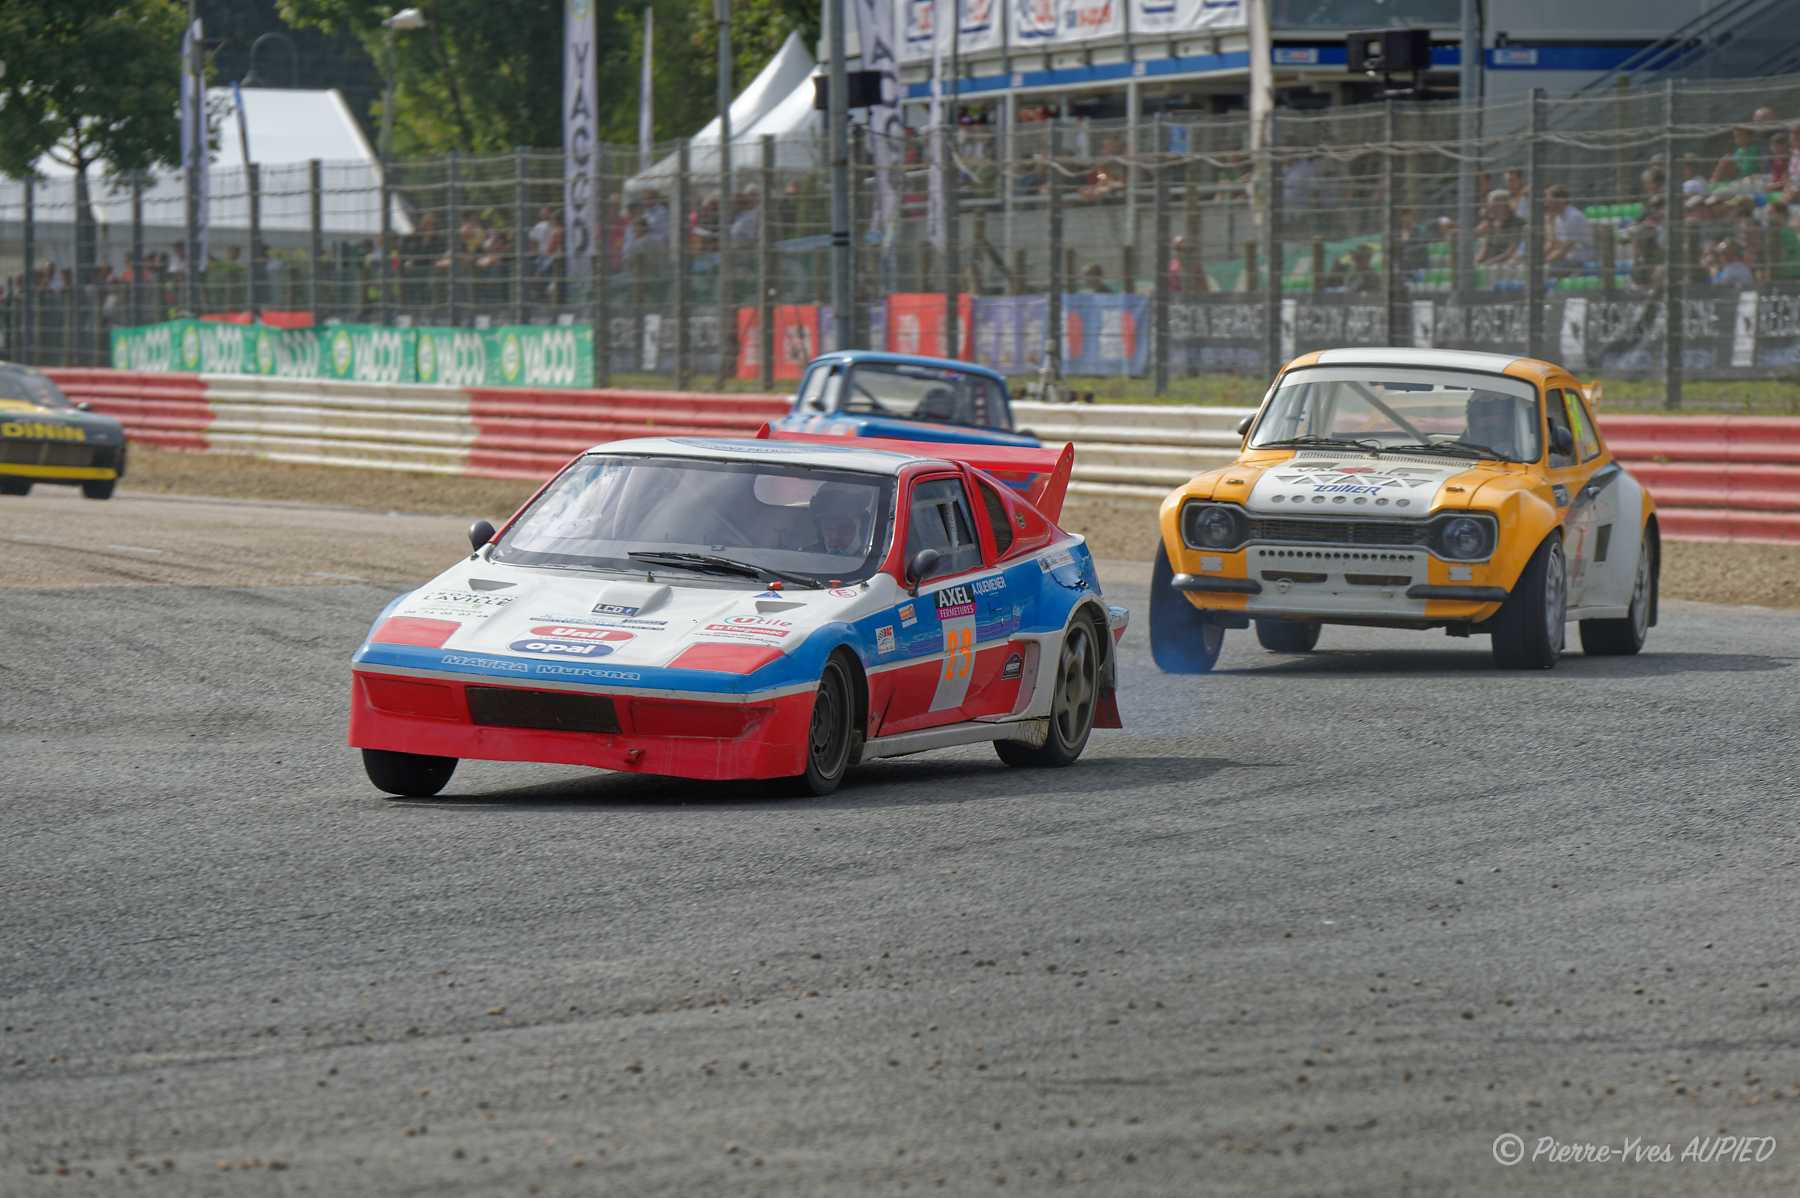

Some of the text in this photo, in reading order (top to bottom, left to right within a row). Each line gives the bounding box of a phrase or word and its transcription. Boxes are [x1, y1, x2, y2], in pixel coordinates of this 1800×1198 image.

[570, 42, 591, 256] YACCO
[202, 324, 243, 375] YACCO
[352, 331, 403, 383] YACCO
[435, 332, 485, 385] YACCO
[522, 329, 576, 385] YACCO
[939, 587, 971, 608] AXEL
[939, 604, 974, 618] FERMETURES
[525, 642, 594, 655] opal
[551, 627, 610, 639] Unil
[441, 655, 641, 682] MATRA Murena
